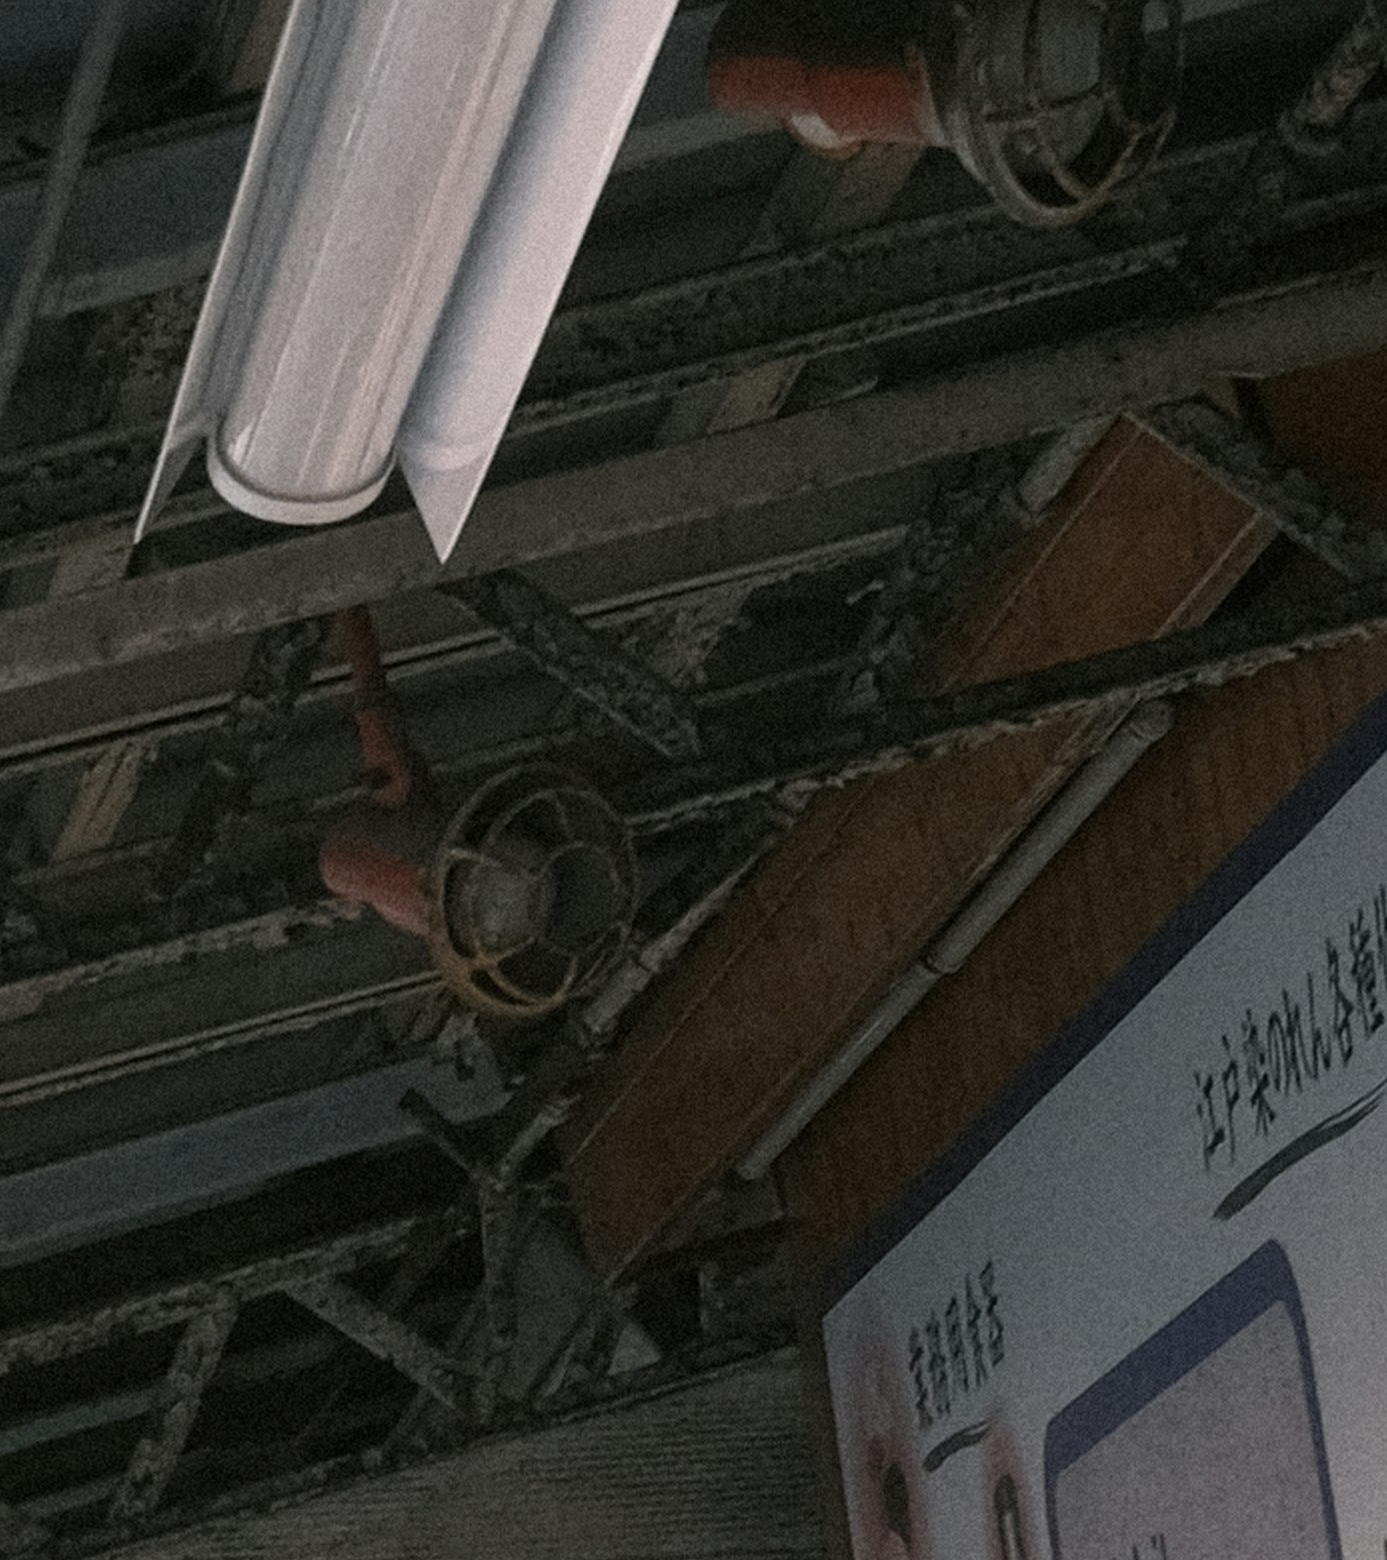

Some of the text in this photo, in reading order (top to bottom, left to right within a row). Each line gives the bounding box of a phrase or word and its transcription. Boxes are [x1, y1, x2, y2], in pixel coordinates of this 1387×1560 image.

[908, 1260, 1004, 1429] 業務用食器
